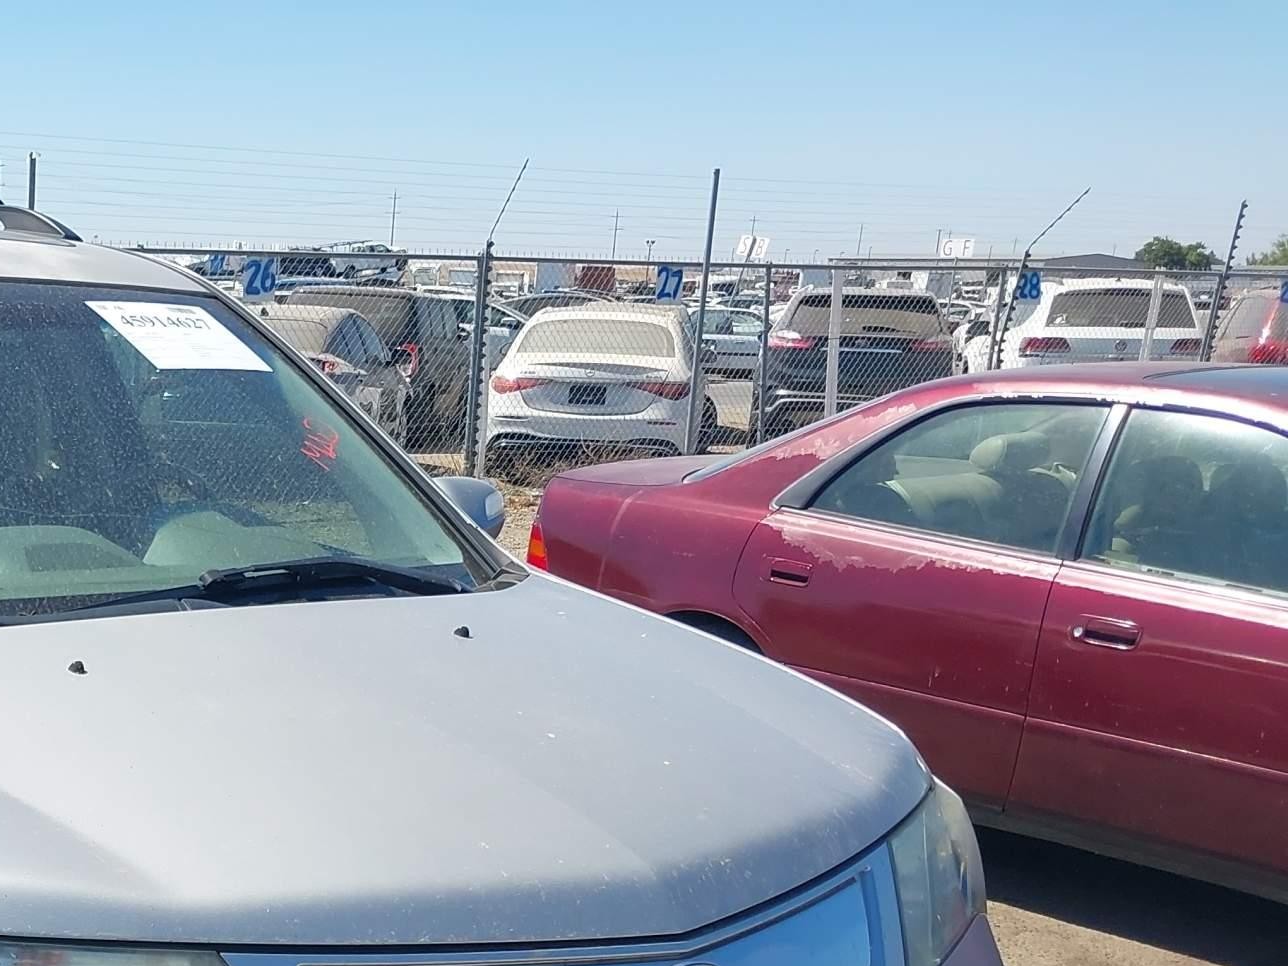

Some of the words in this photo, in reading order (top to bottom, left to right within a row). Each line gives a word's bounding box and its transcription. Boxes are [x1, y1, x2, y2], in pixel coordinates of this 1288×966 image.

[943, 240, 953, 257] G
[962, 240, 971, 257] F
[244, 258, 276, 295] 26
[657, 266, 684, 301] 27
[1018, 271, 1041, 299] 28
[120, 314, 211, 331] 45914627
